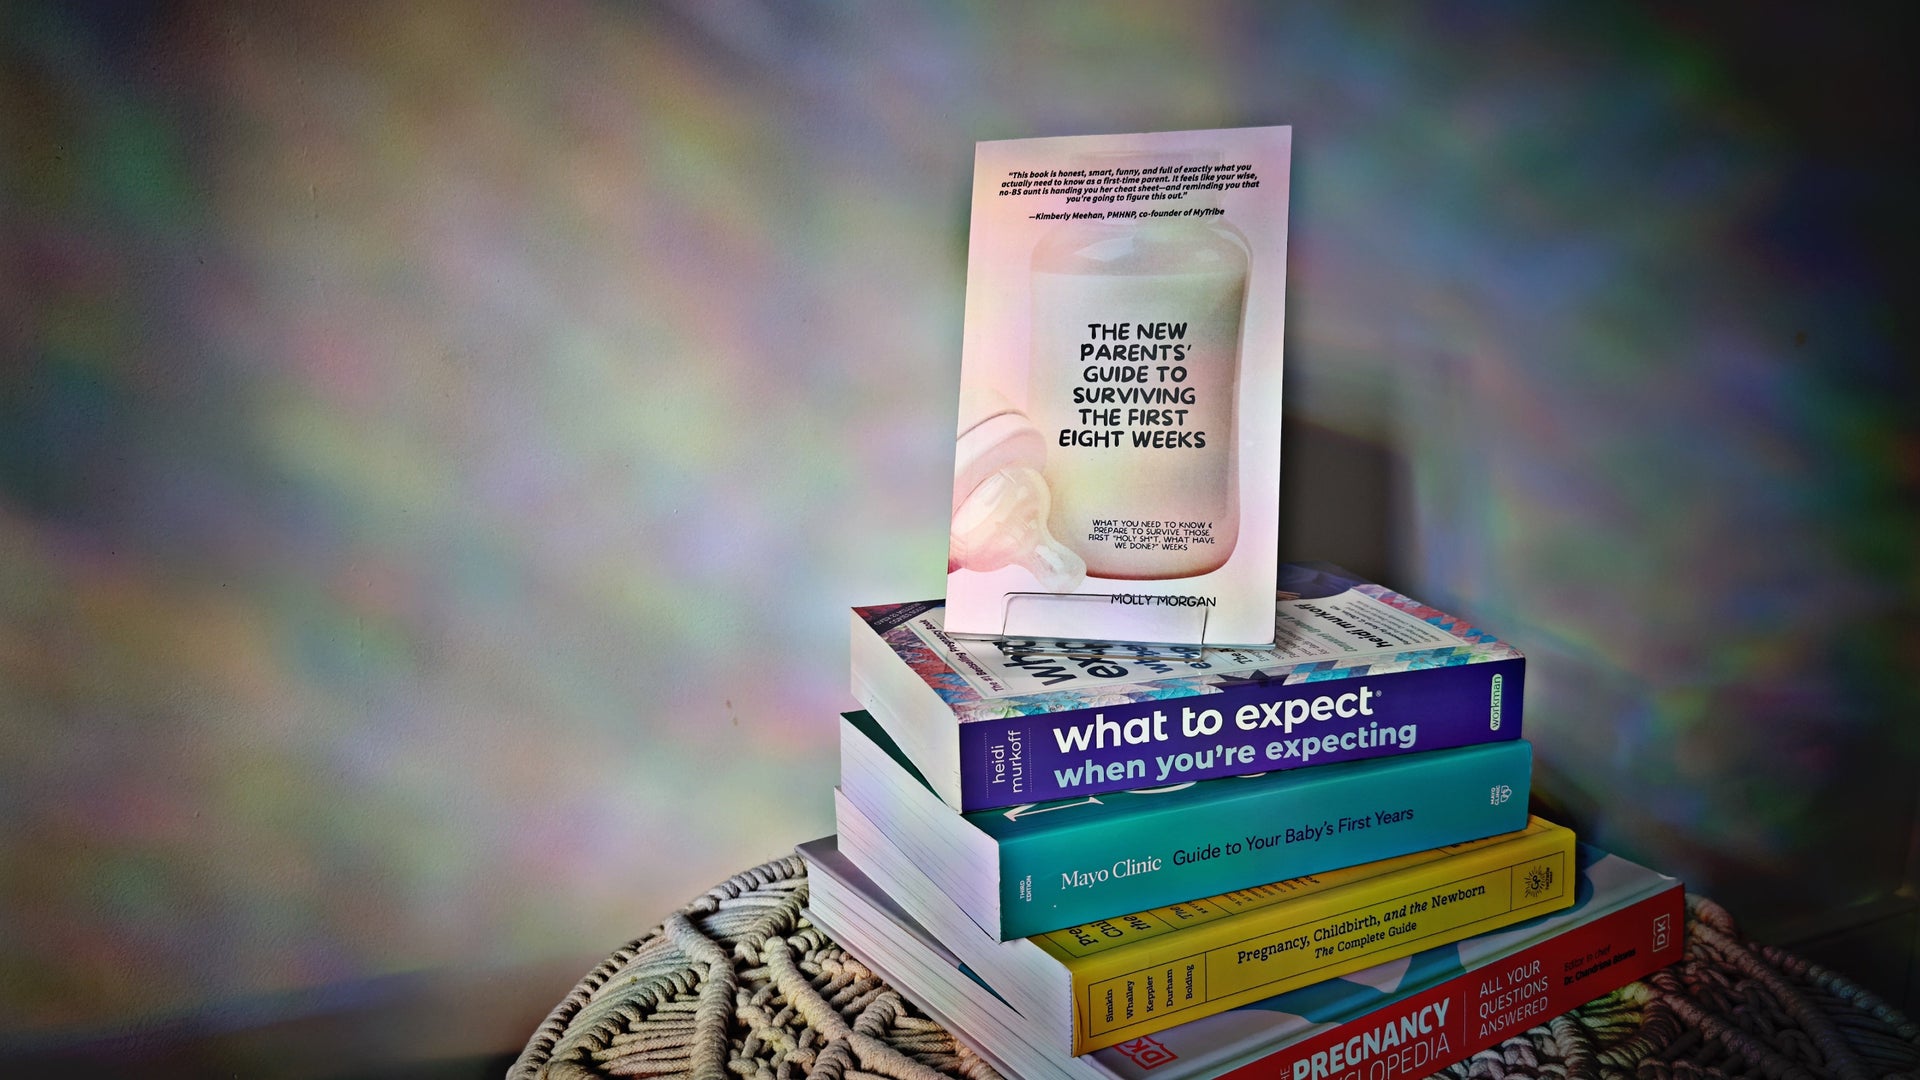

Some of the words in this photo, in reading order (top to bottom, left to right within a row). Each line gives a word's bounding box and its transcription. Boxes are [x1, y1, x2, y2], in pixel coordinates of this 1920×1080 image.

[1002, 179, 1032, 188] actually
[1034, 178, 1052, 186] need
[1064, 178, 1085, 186] know
[1104, 176, 1140, 184] first-time
[1141, 176, 1170, 184] parent.
[1180, 174, 1198, 182] feels
[1216, 174, 1235, 182] your
[1237, 172, 1258, 180] wise,
[1050, 170, 1056, 178] is
[1058, 170, 1086, 178] honest,
[1088, 169, 1114, 177] smart,
[1116, 168, 1140, 176] funny,
[1159, 166, 1172, 175] full
[1174, 166, 1182, 174] of
[1184, 165, 1212, 174] exactly
[1214, 164, 1235, 172] what
[1236, 164, 1252, 172] you
[999, 188, 1022, 196] no-BS
[1050, 187, 1082, 196] handing
[1100, 186, 1113, 194] her
[1114, 185, 1136, 193] cheat
[1138, 183, 1181, 192] sheet—and
[1182, 182, 1223, 190] reminding
[1225, 182, 1240, 190] you
[1066, 195, 1092, 204] you’re
[1092, 194, 1115, 204] going
[1116, 194, 1125, 202] to
[1126, 194, 1149, 202] figure
[1152, 192, 1166, 200] this
[1168, 192, 1188, 200] out.”
[1028, 212, 1072, 220] —Kimberly
[1072, 212, 1105, 220] Meehan,
[1106, 210, 1137, 218] PMHNP,
[1139, 209, 1182, 218] co-founder
[1184, 208, 1192, 216] of
[1193, 208, 1225, 218] MyTribe
[1088, 322, 1130, 340] THE
[1137, 322, 1188, 340] NEW
[1080, 344, 1192, 362] PARENTS’
[1084, 366, 1149, 383] GUIDE
[1156, 366, 1188, 382] TO
[1073, 387, 1196, 404] SURVIVING
[1078, 408, 1122, 426] THE
[1128, 409, 1188, 426] FIRST
[1059, 429, 1124, 448] EIGHT
[1132, 430, 1206, 448] WEEKS
[1094, 526, 1128, 534] PREPARE
[1146, 528, 1180, 536] SURVIVE
[1121, 520, 1138, 528] YOU
[1142, 520, 1161, 528] NEED
[1164, 536, 1190, 544] WHAT
[1110, 593, 1150, 606] MOLLY
[1157, 595, 1216, 607] MORGAN
[919, 620, 936, 630] Book
[1293, 604, 1356, 628] murkoff
[932, 630, 960, 652] Pregnancy
[1346, 628, 1394, 648] heidi
[956, 652, 987, 676] Bestselling
[1232, 652, 1253, 664] The
[990, 682, 1004, 692] The
[1491, 676, 1502, 728] workman
[1053, 710, 1168, 754] what
[1182, 707, 1222, 738] to
[992, 744, 1004, 784] heidi
[1008, 730, 1023, 794] murkoff
[1054, 757, 1146, 788] when
[1156, 744, 1256, 780] you’re
[1266, 721, 1416, 761] expecting
[1061, 867, 1108, 890] Mayo
[1112, 856, 1162, 879] Clinic
[1172, 846, 1221, 866] Guide
[1225, 842, 1242, 856] to
[1245, 834, 1280, 851] Your
[1286, 820, 1334, 844] Baby’s
[1338, 814, 1372, 833] First
[1374, 808, 1414, 826] Years
[1170, 906, 1194, 920] The
[1123, 915, 1152, 931] the
[1237, 935, 1311, 964] Pregnancy,
[1314, 915, 1380, 942] Childbirth,
[1384, 906, 1406, 922] and
[1410, 901, 1428, 914] the
[1432, 884, 1486, 908] Newborn
[1656, 918, 1666, 946] DK
[1314, 946, 1334, 959] The
[1337, 931, 1386, 952] Complete
[1388, 922, 1417, 936] Guide
[1564, 956, 1584, 972] Editor
[1186, 964, 1194, 1000] Bolding
[1479, 977, 1503, 998] ALL
[1506, 960, 1540, 986] YOUR
[1564, 976, 1574, 986] Dr.
[1126, 980, 1134, 1020] Whalley
[1146, 976, 1154, 1013] Keppler
[1479, 976, 1548, 1020] QUESTIONS
[1106, 988, 1114, 1022] Simkin
[1478, 996, 1548, 1040] ANSWERED
[1293, 997, 1450, 1080] PREGNANCY
